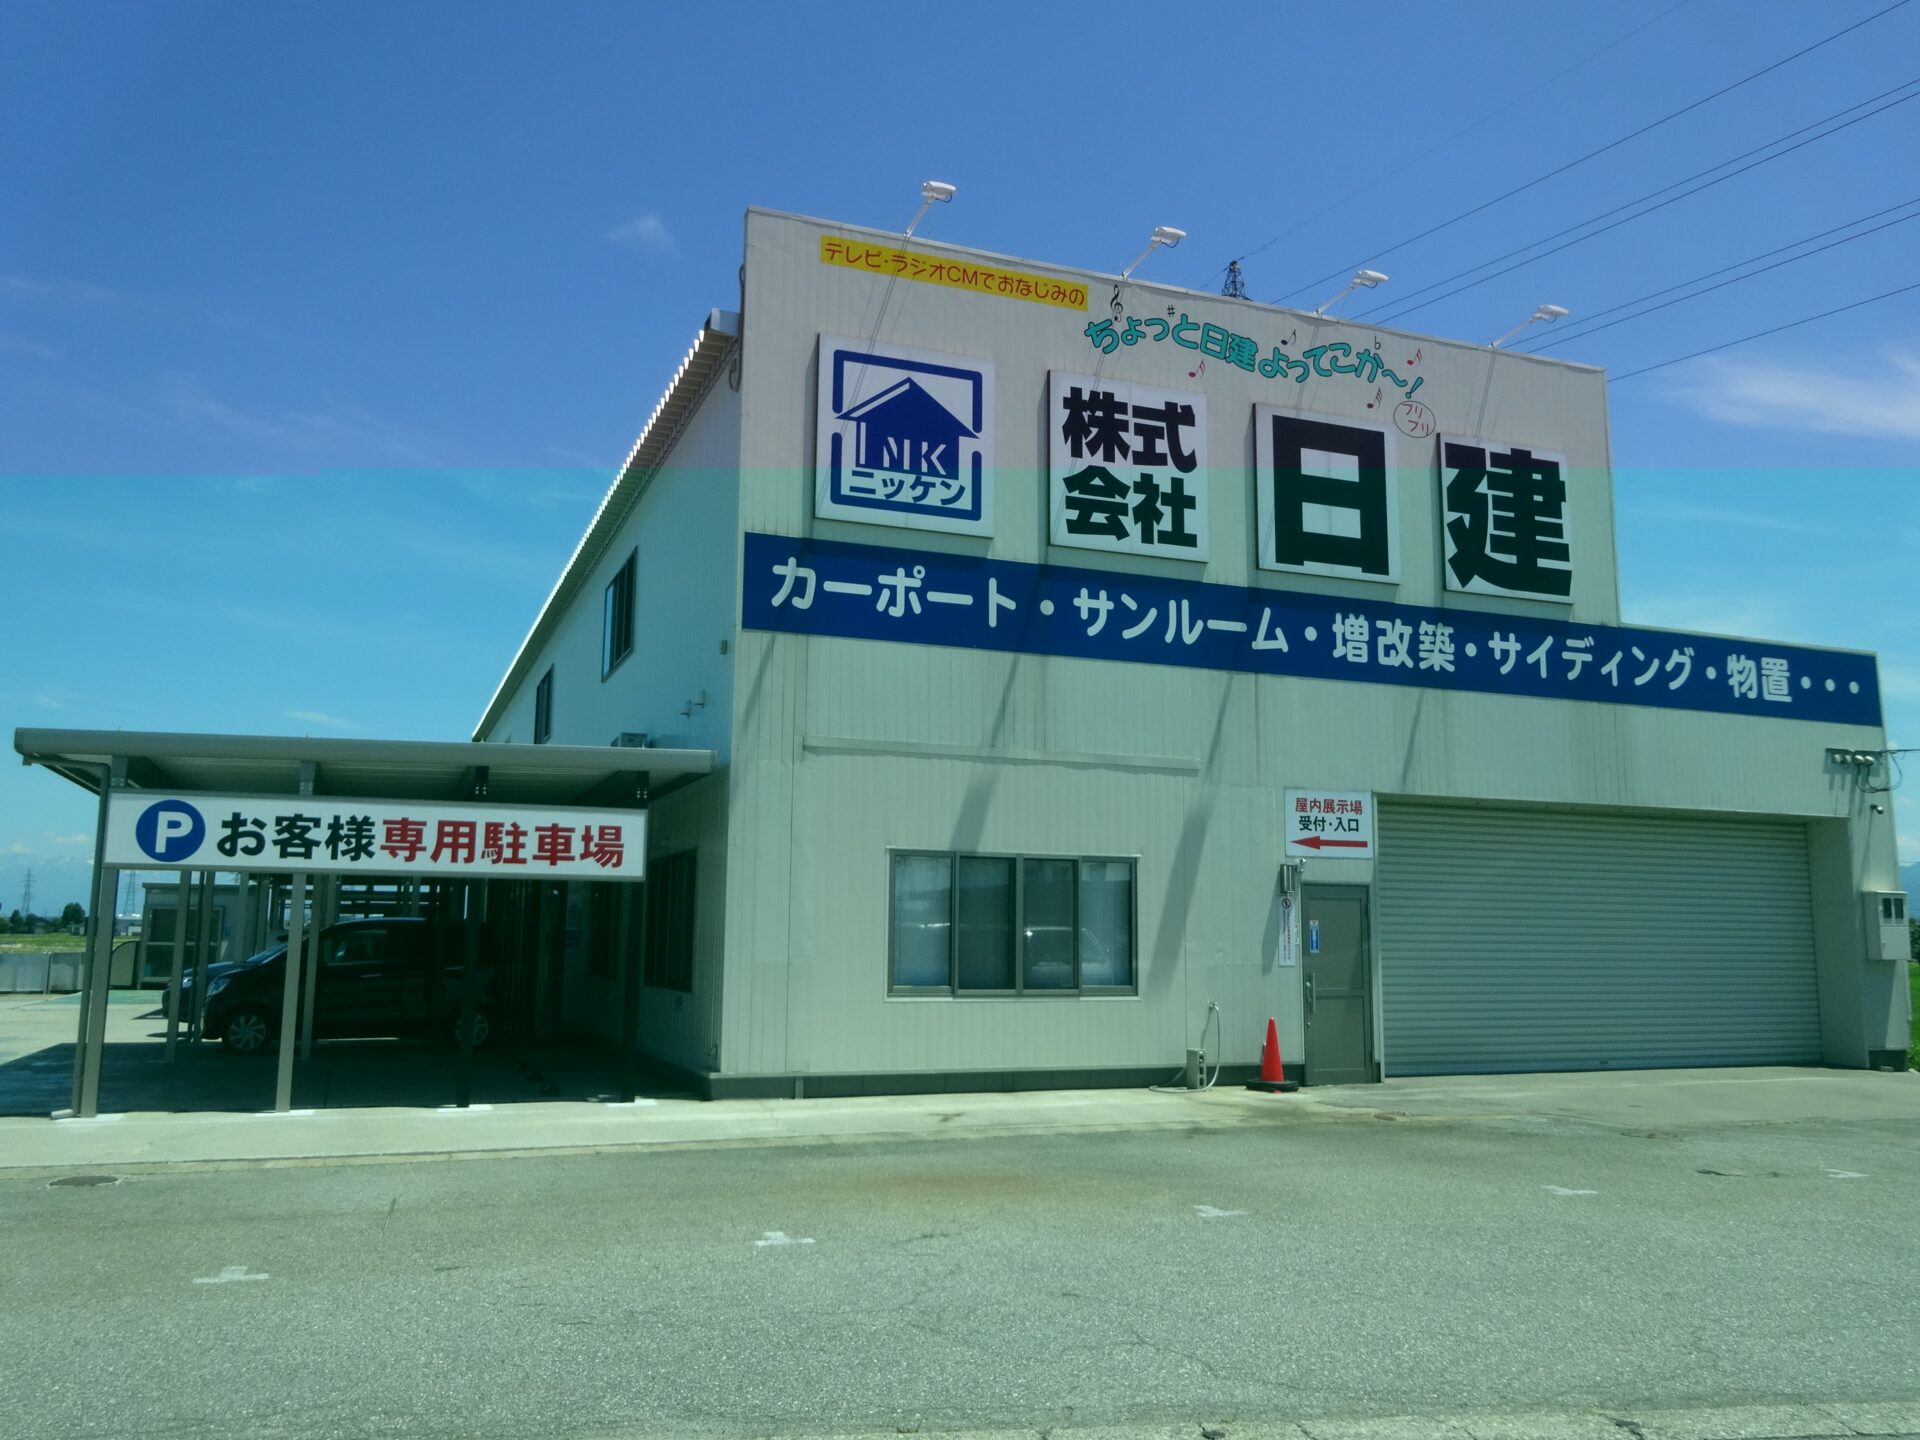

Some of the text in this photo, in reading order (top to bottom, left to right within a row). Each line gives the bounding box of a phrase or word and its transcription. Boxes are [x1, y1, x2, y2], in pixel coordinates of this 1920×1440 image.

[825, 242, 1085, 306] テレビ・ラジオCMでおなじみの
[1063, 387, 1197, 473] 株式
[849, 470, 965, 505] ニッケン
[1063, 465, 1197, 548] 会社
[1295, 797, 1363, 815] 屋内展示場
[1298, 815, 1360, 832] 受付・入口
[155, 811, 625, 868] P お客様専用駐車場
